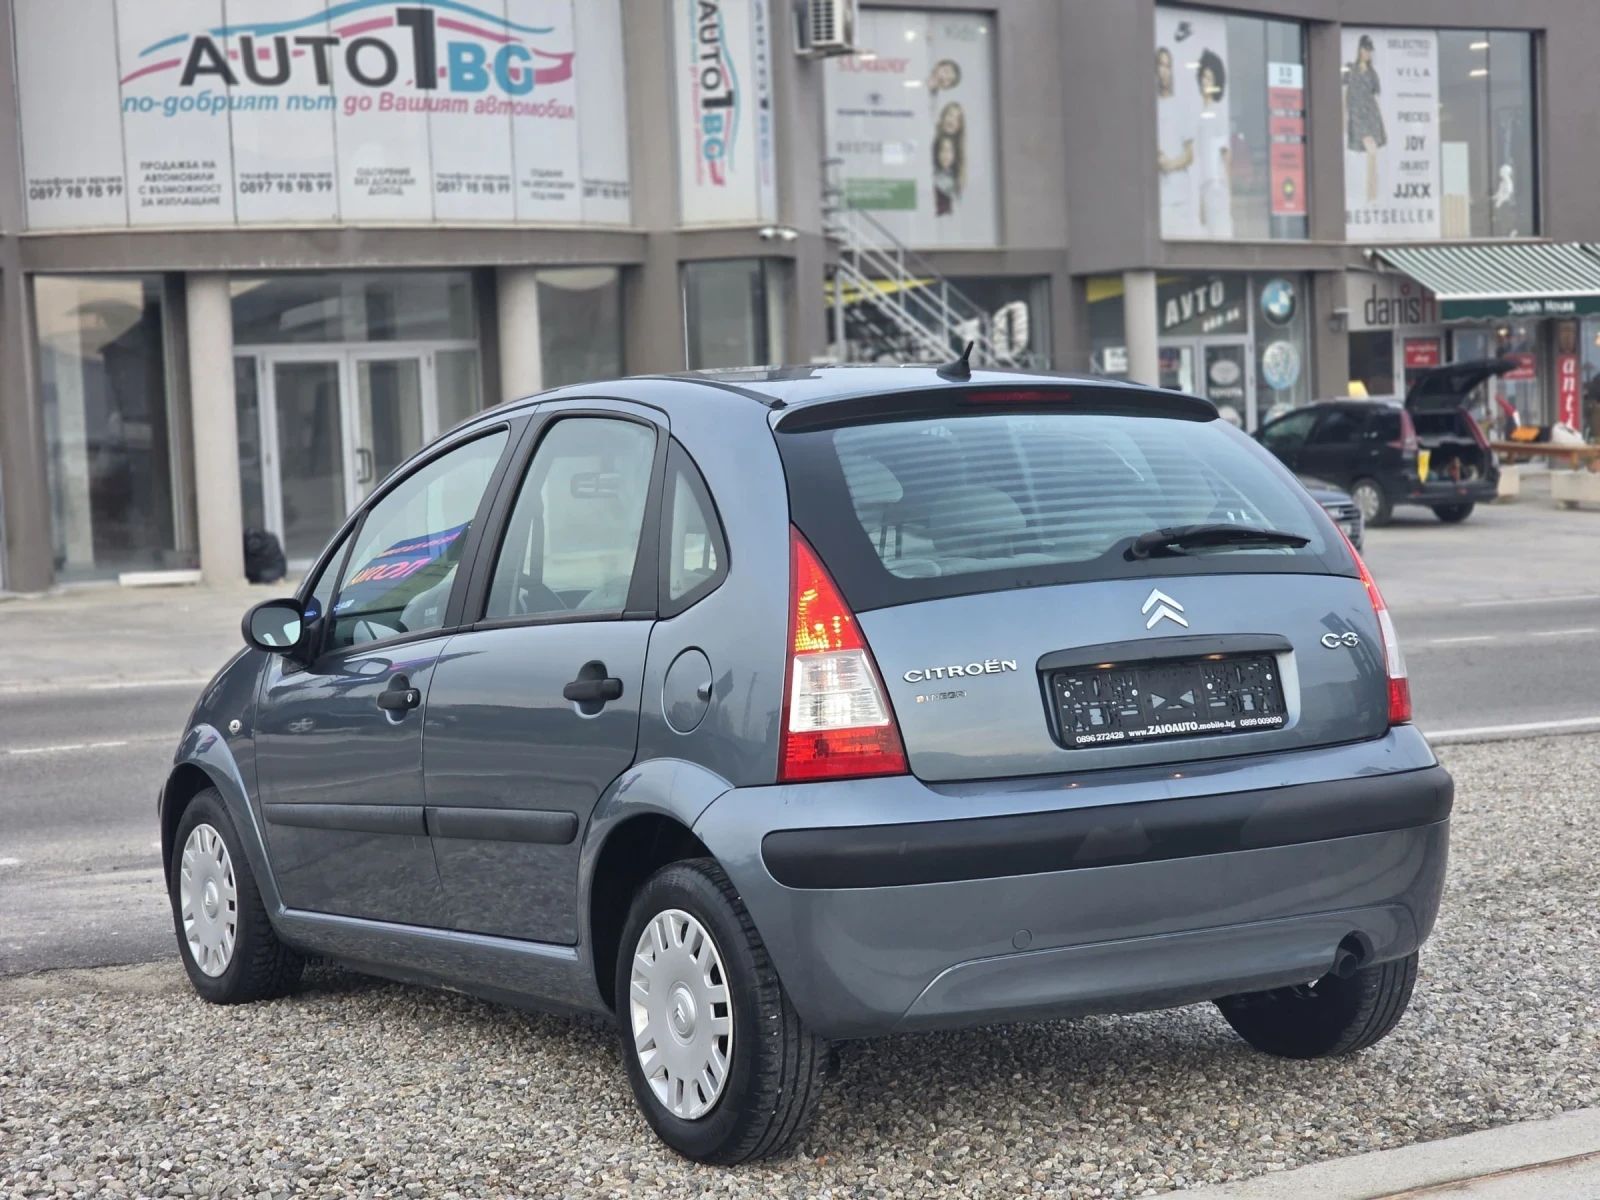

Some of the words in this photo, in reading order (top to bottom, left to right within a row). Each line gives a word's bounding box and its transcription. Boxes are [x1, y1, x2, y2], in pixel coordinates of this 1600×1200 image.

[1396, 67, 1431, 78] VILA
[123, 90, 279, 117] по-добрият
[286, 98, 338, 113] път
[344, 96, 373, 117] до
[378, 92, 469, 115] Вашият
[473, 94, 575, 120] автомобил
[107, 185, 123, 197] 99
[317, 181, 332, 192] 99
[1393, 183, 1431, 199] JJXX
[1346, 209, 1434, 225] BESTSELLER
[1365, 284, 1437, 325] danish
[1321, 631, 1359, 649] C3
[903, 659, 1018, 683] CITROËN
[1076, 733, 1096, 744] 0896
[1096, 730, 1125, 742] 272428
[1128, 720, 1236, 737] www.ZAIOAUTO.mobile.bg
[1240, 717, 1257, 727] 0899
